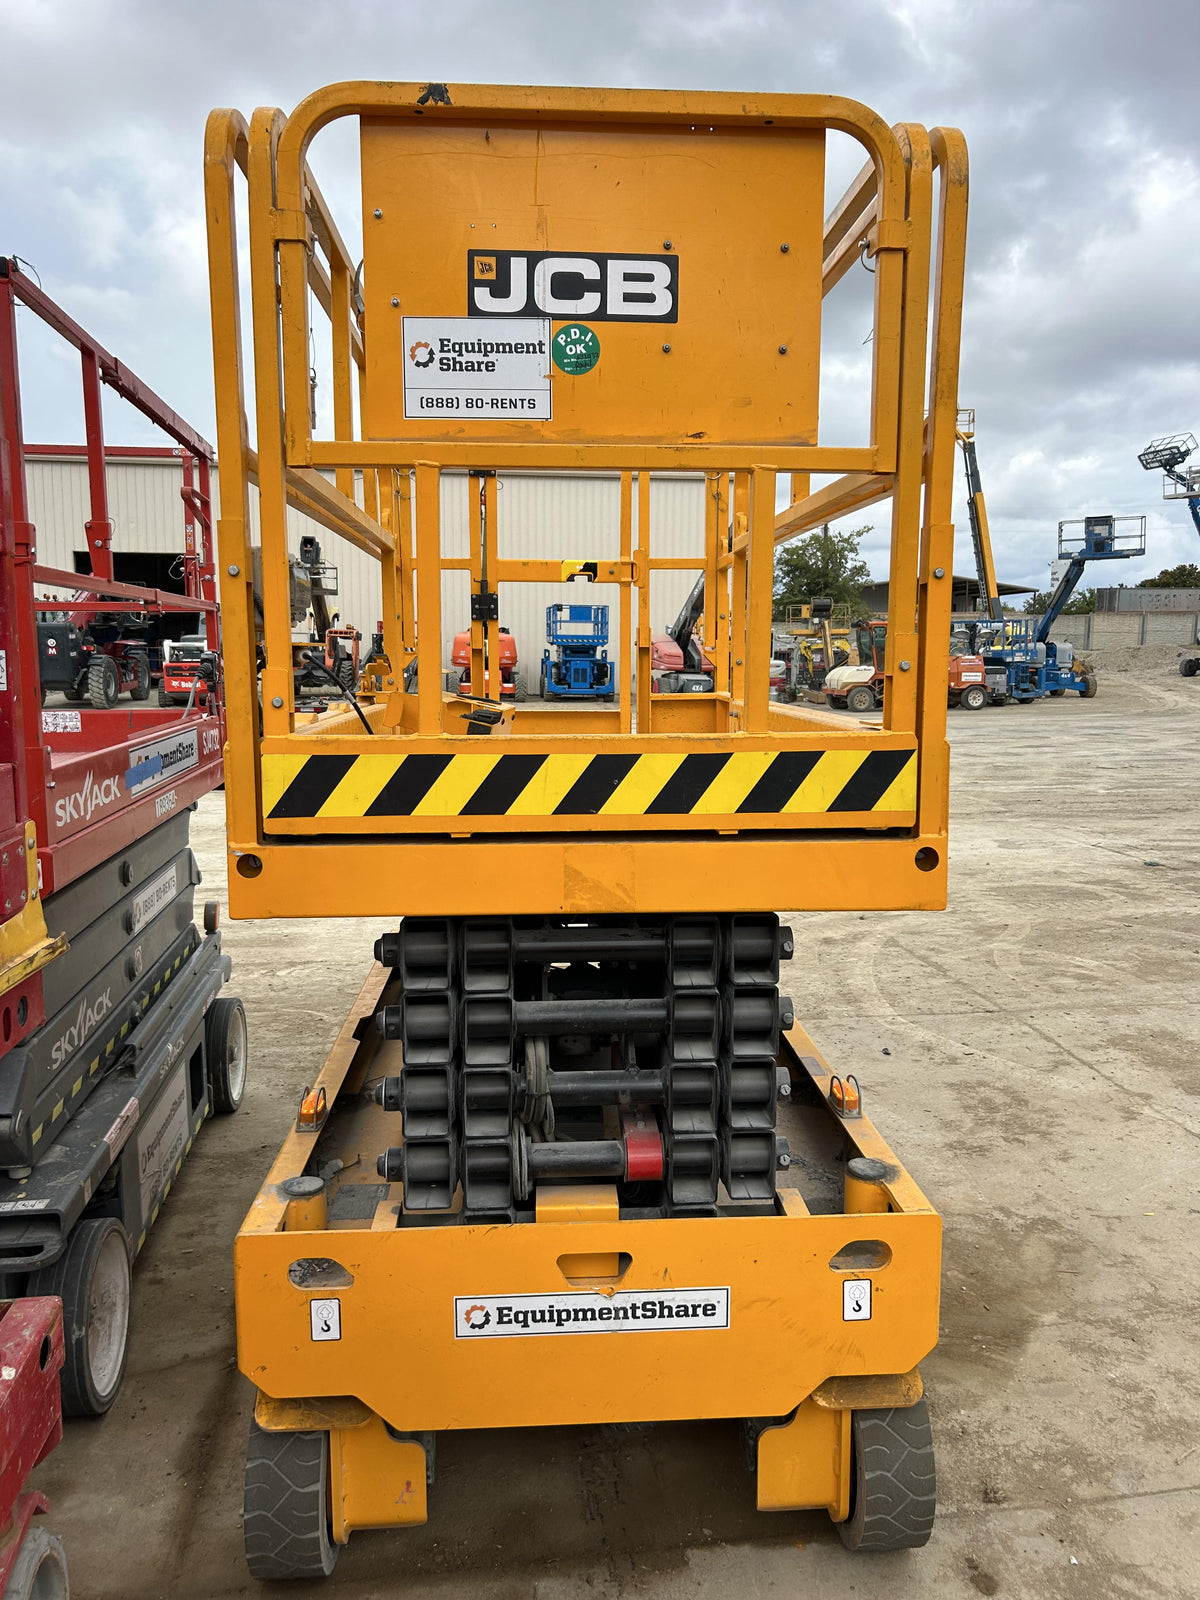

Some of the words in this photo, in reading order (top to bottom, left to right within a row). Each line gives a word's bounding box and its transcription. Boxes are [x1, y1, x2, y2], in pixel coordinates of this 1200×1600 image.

[474, 257, 673, 316] JCB
[439, 338, 545, 357] Equipment
[566, 344, 587, 355] OK
[439, 357, 496, 372] Share
[420, 396, 460, 409] (888)
[465, 397, 536, 409] 80-RENTS
[55, 769, 121, 827] SKYJACK
[51, 986, 113, 1070] SKYJACK
[496, 1301, 717, 1327] EquipmentShare
